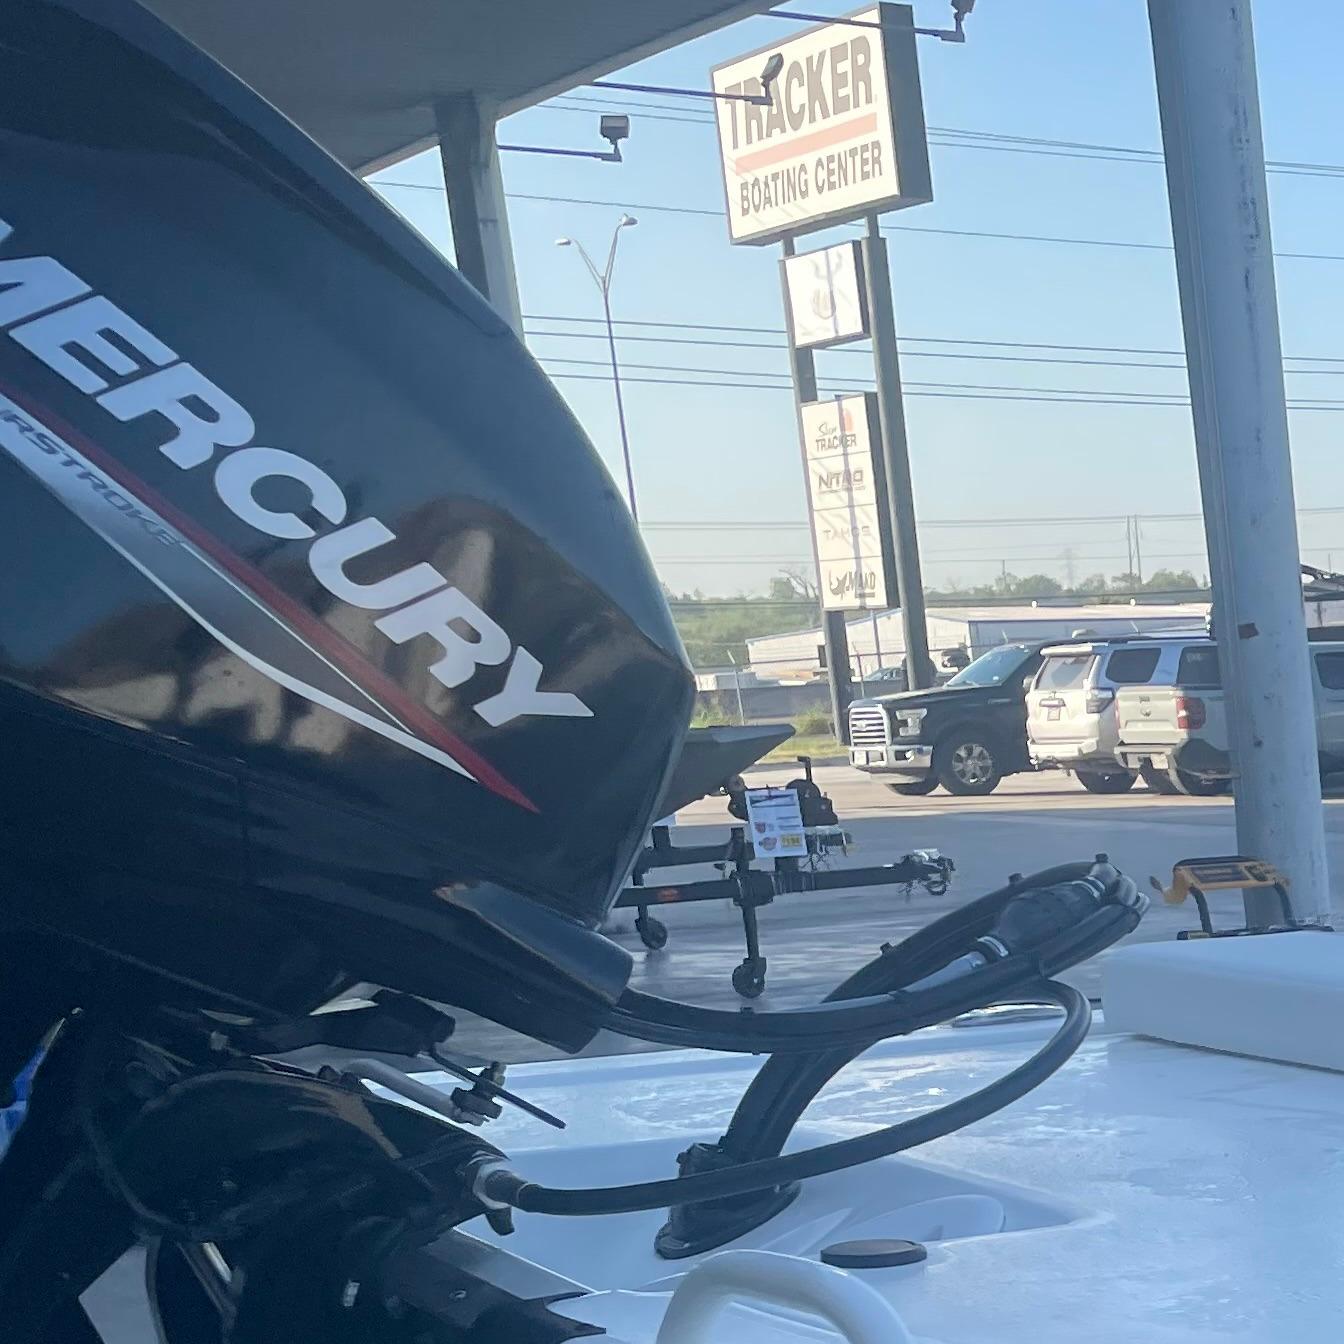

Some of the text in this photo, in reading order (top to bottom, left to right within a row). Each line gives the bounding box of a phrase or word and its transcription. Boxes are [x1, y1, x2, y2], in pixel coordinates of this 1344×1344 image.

[725, 35, 872, 150] TRACKER
[740, 140, 883, 217] BOATING CENTER
[0, 409, 179, 547] RSTROKE
